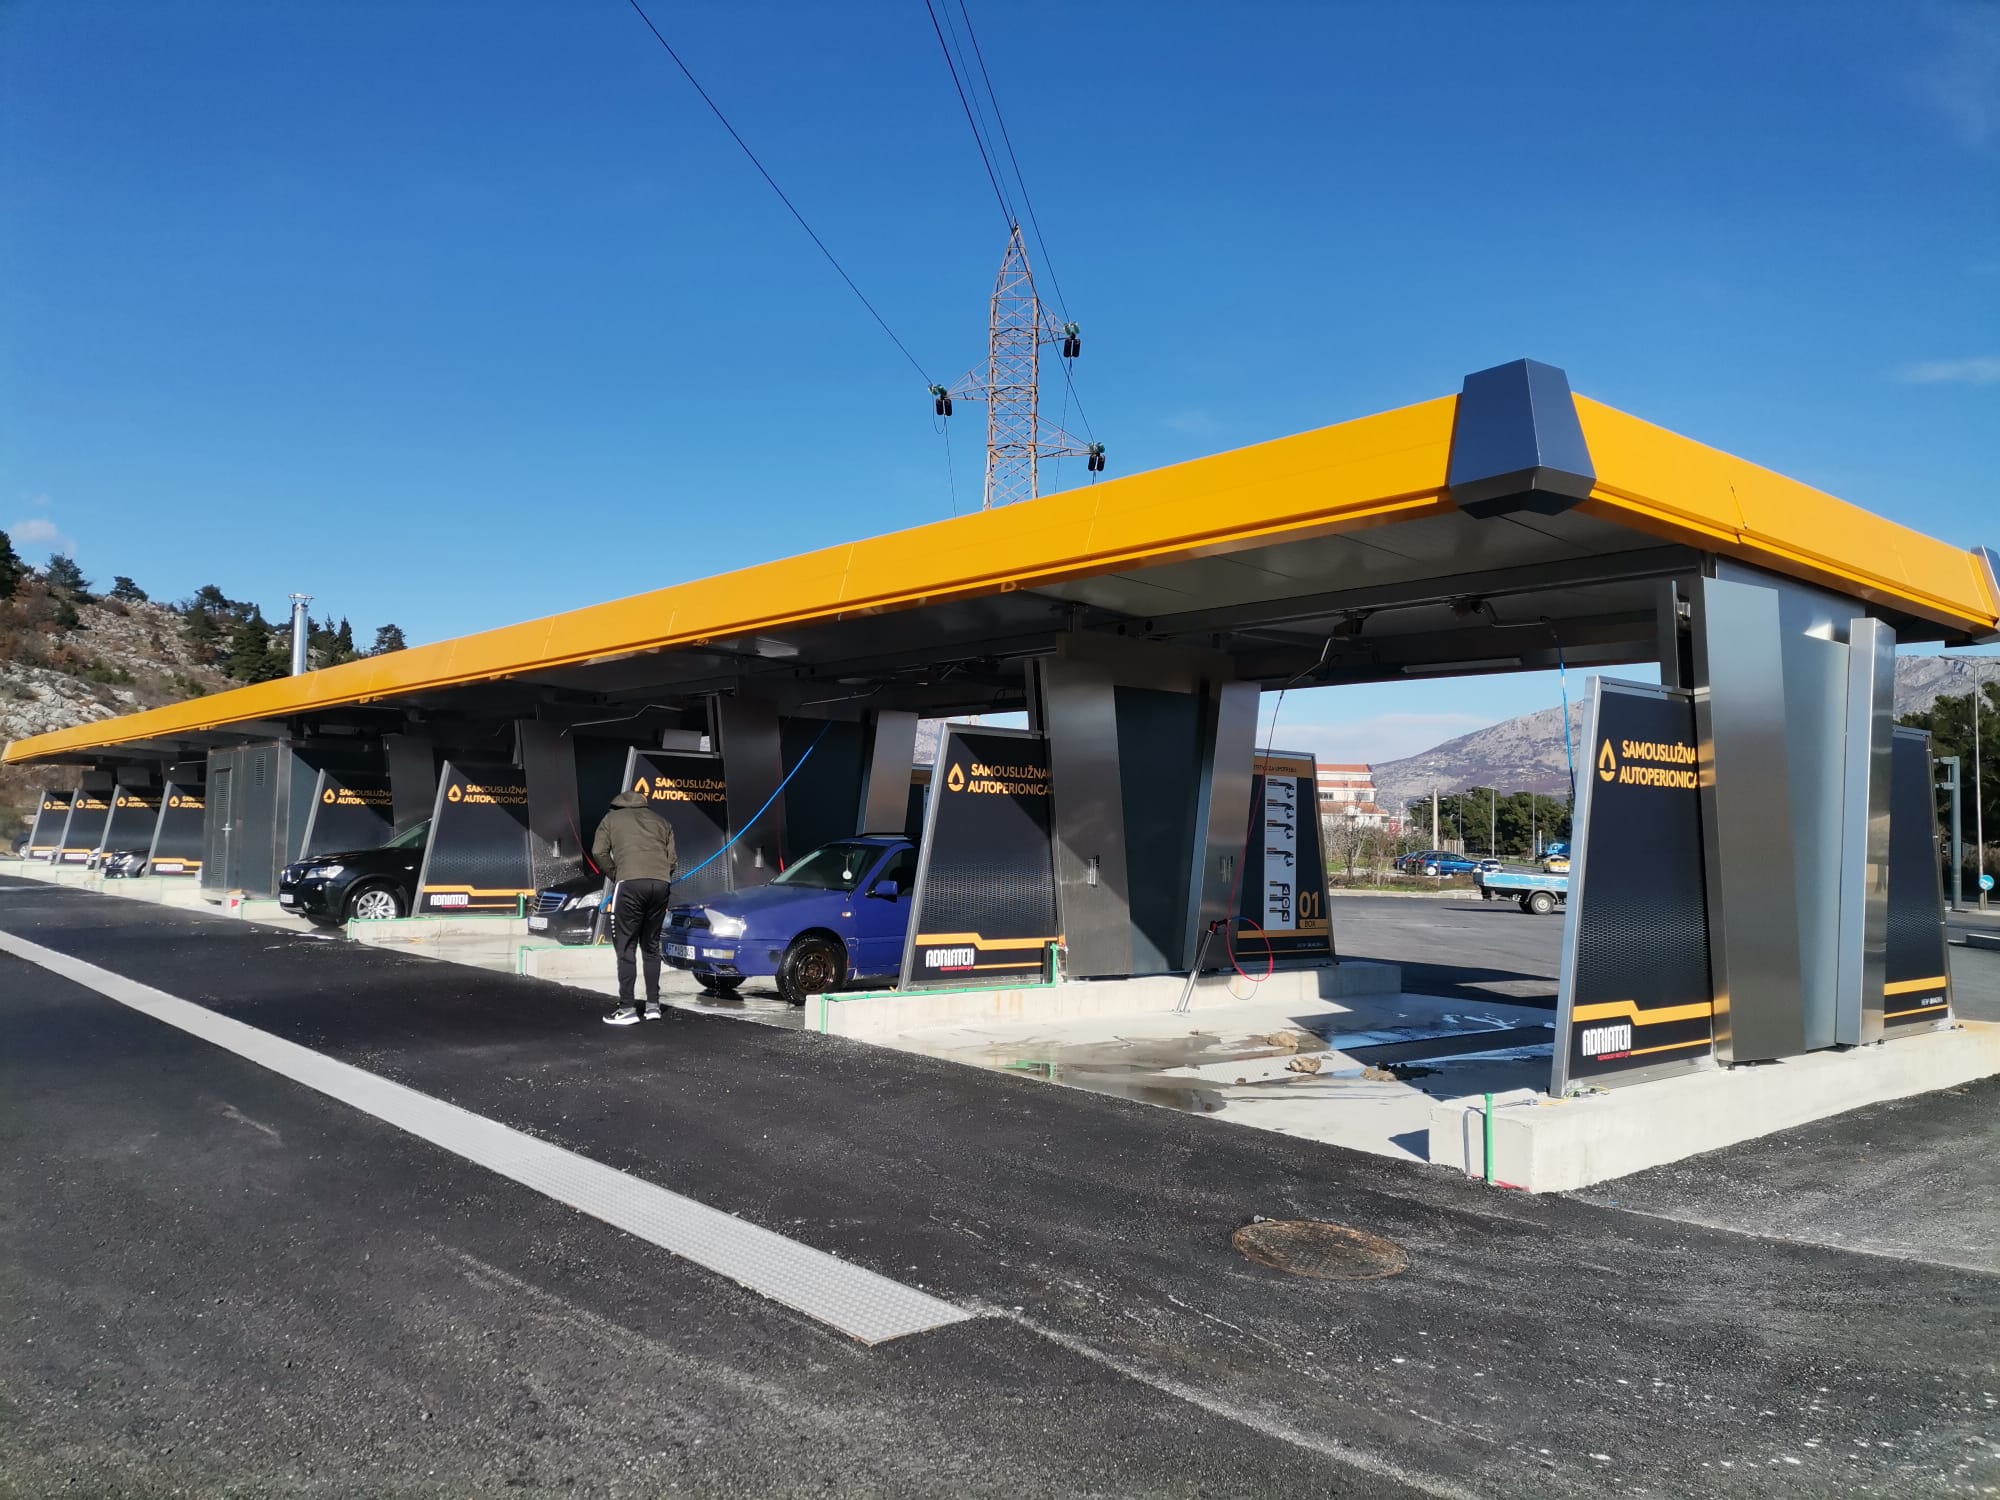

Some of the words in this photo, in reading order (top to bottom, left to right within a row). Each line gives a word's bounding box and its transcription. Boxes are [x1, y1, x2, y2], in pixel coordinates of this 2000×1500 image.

[1622, 740, 1696, 765] SAMOUSLUŽNA
[971, 764, 1049, 779] SAMOUSLUŽNA
[1619, 766, 1697, 789] AUTOPERIONICA
[655, 777, 724, 789] SAMOUSLUŽNA
[967, 781, 1051, 796] AUTOPERIONICA
[651, 789, 725, 802] AUTOPERIONICA
[1299, 891, 1319, 918] 01
